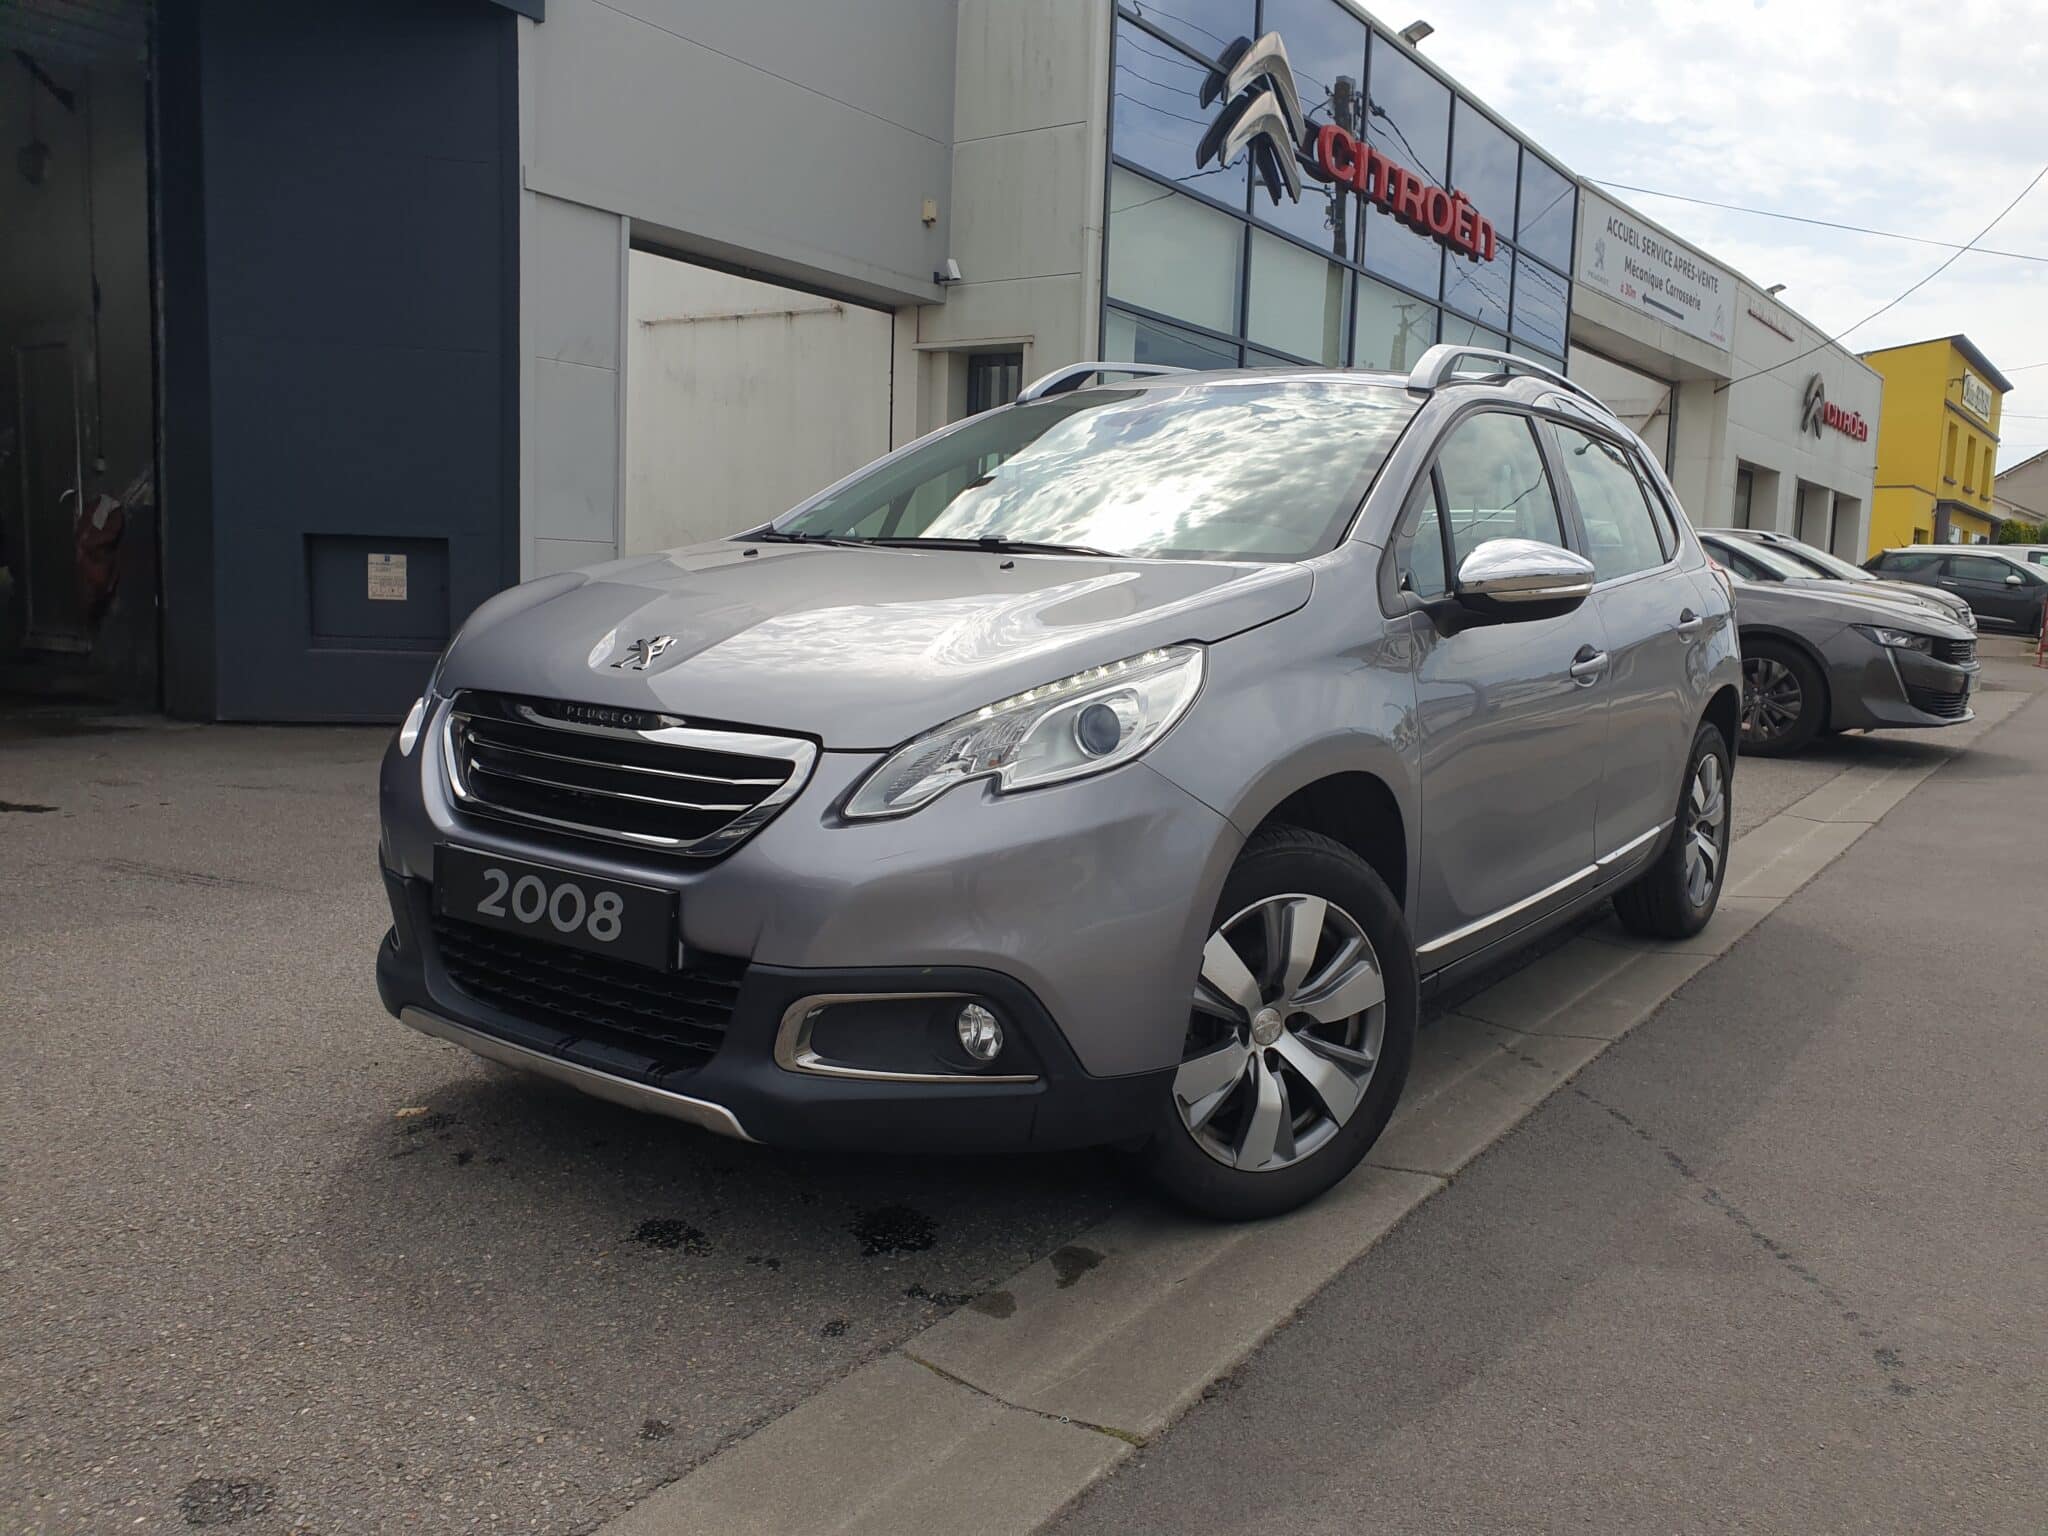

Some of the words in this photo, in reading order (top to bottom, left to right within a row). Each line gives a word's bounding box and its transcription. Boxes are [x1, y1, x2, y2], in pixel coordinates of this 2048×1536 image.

[1317, 124, 1497, 262] CITROËN
[1606, 215, 1641, 250] ACCUEIL
[1641, 235, 1674, 268] SERVICE
[1624, 255, 1664, 291] Mécanique
[1665, 277, 1701, 312] Carrosserie
[566, 704, 643, 725] PEUGEOT
[476, 868, 624, 942] 2008
